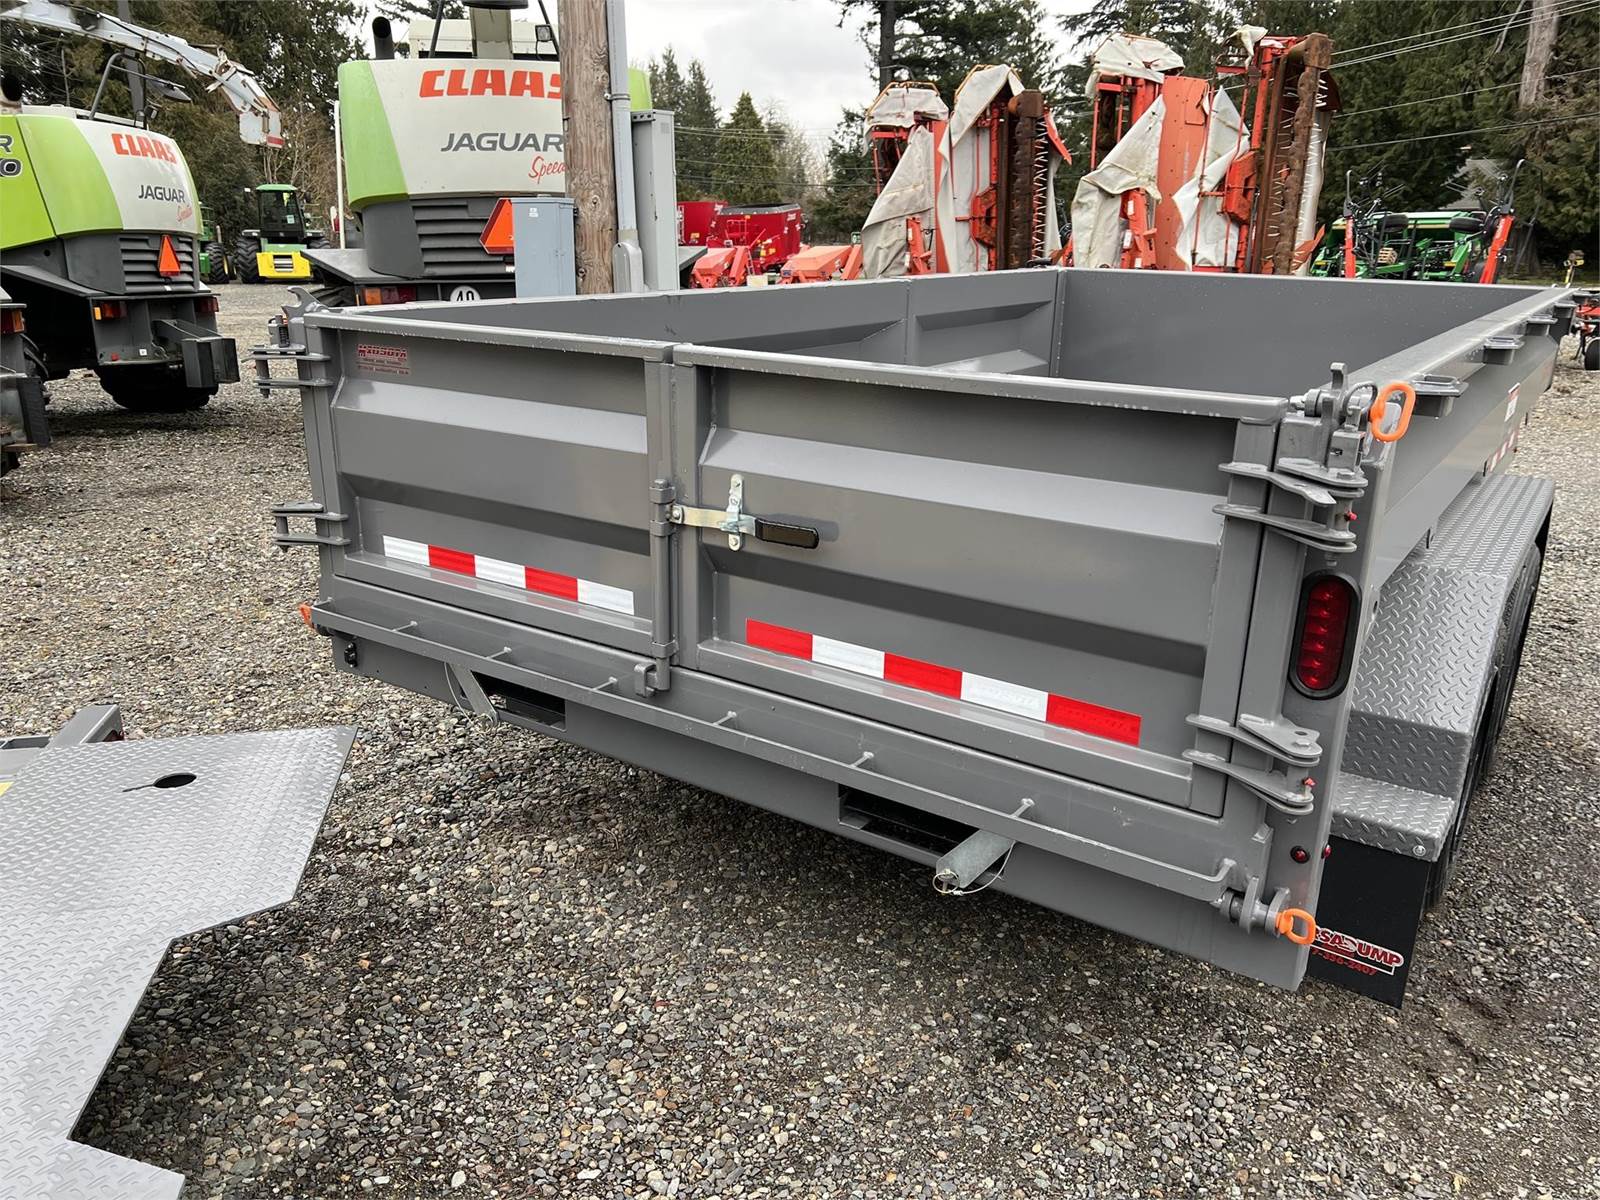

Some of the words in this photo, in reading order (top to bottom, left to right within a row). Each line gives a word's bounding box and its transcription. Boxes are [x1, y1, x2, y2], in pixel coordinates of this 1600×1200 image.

[111, 132, 178, 165] CLAAS
[440, 132, 564, 152] JAGUAR
[138, 184, 186, 204] JAGUAR
